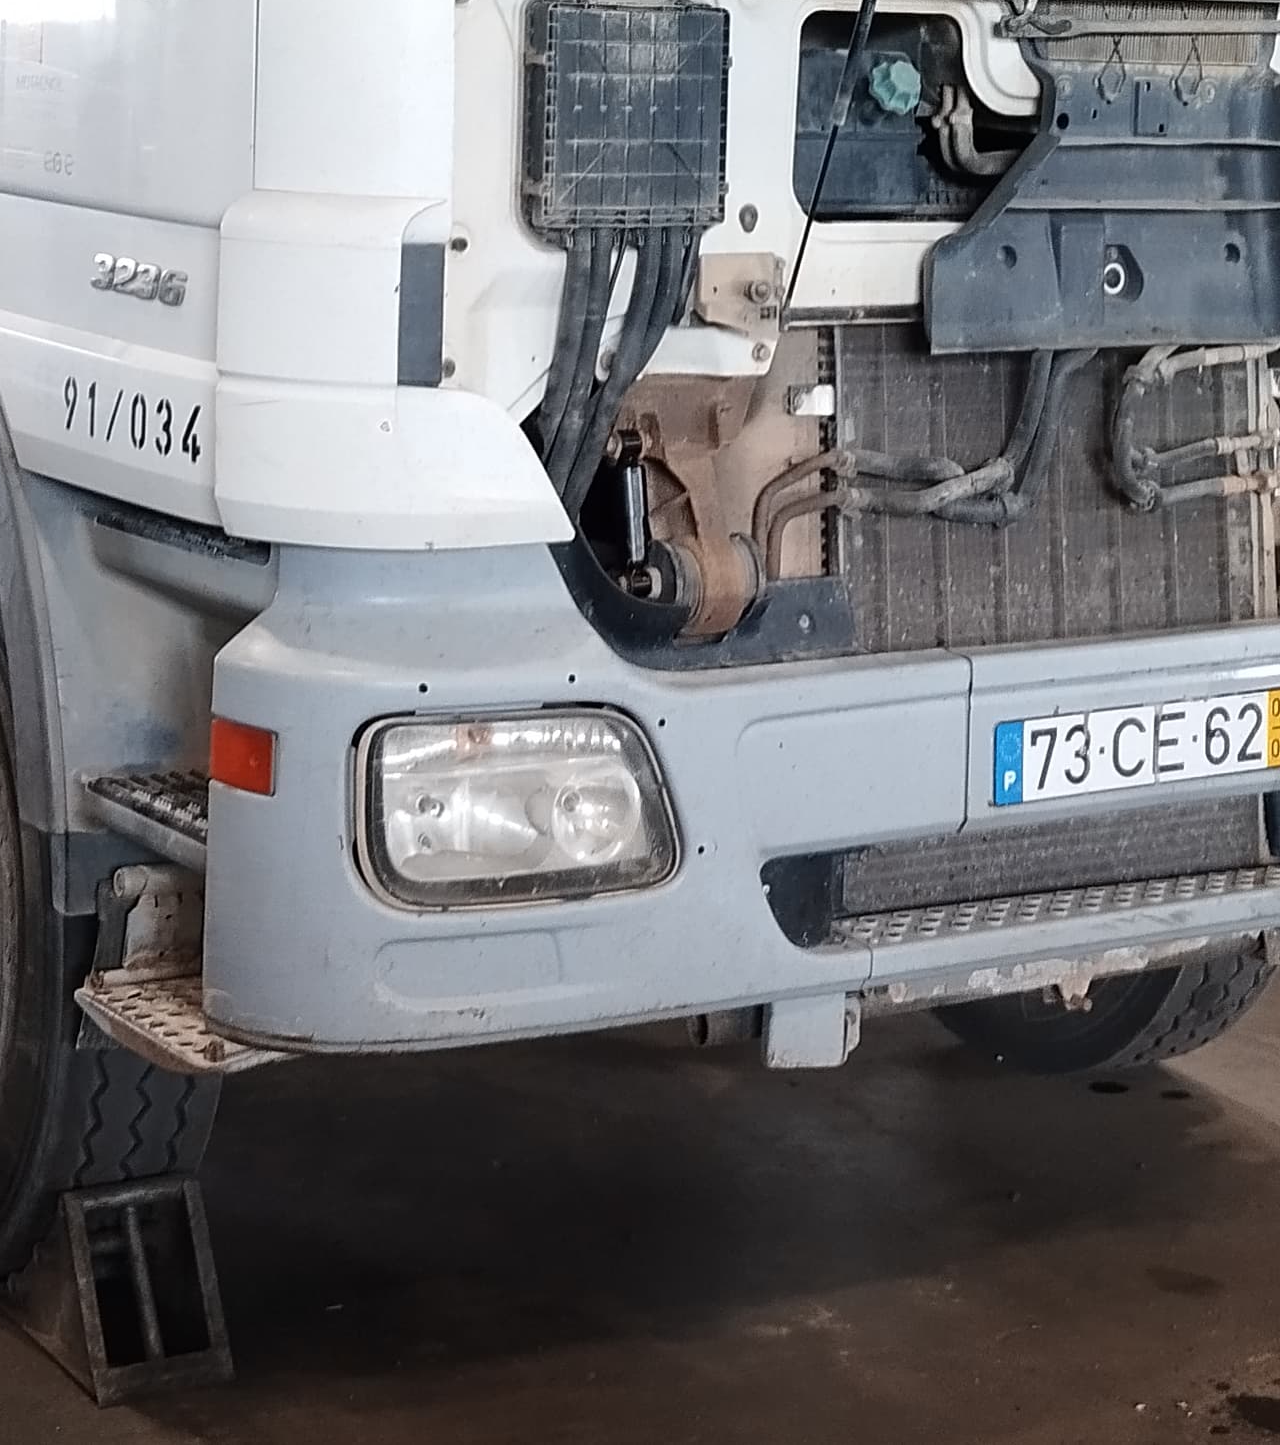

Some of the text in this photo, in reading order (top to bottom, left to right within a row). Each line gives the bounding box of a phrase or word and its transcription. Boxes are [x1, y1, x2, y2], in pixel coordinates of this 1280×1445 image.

[90, 252, 189, 307] 3236
[64, 375, 201, 464] 91/034
[1003, 769, 1017, 792] P
